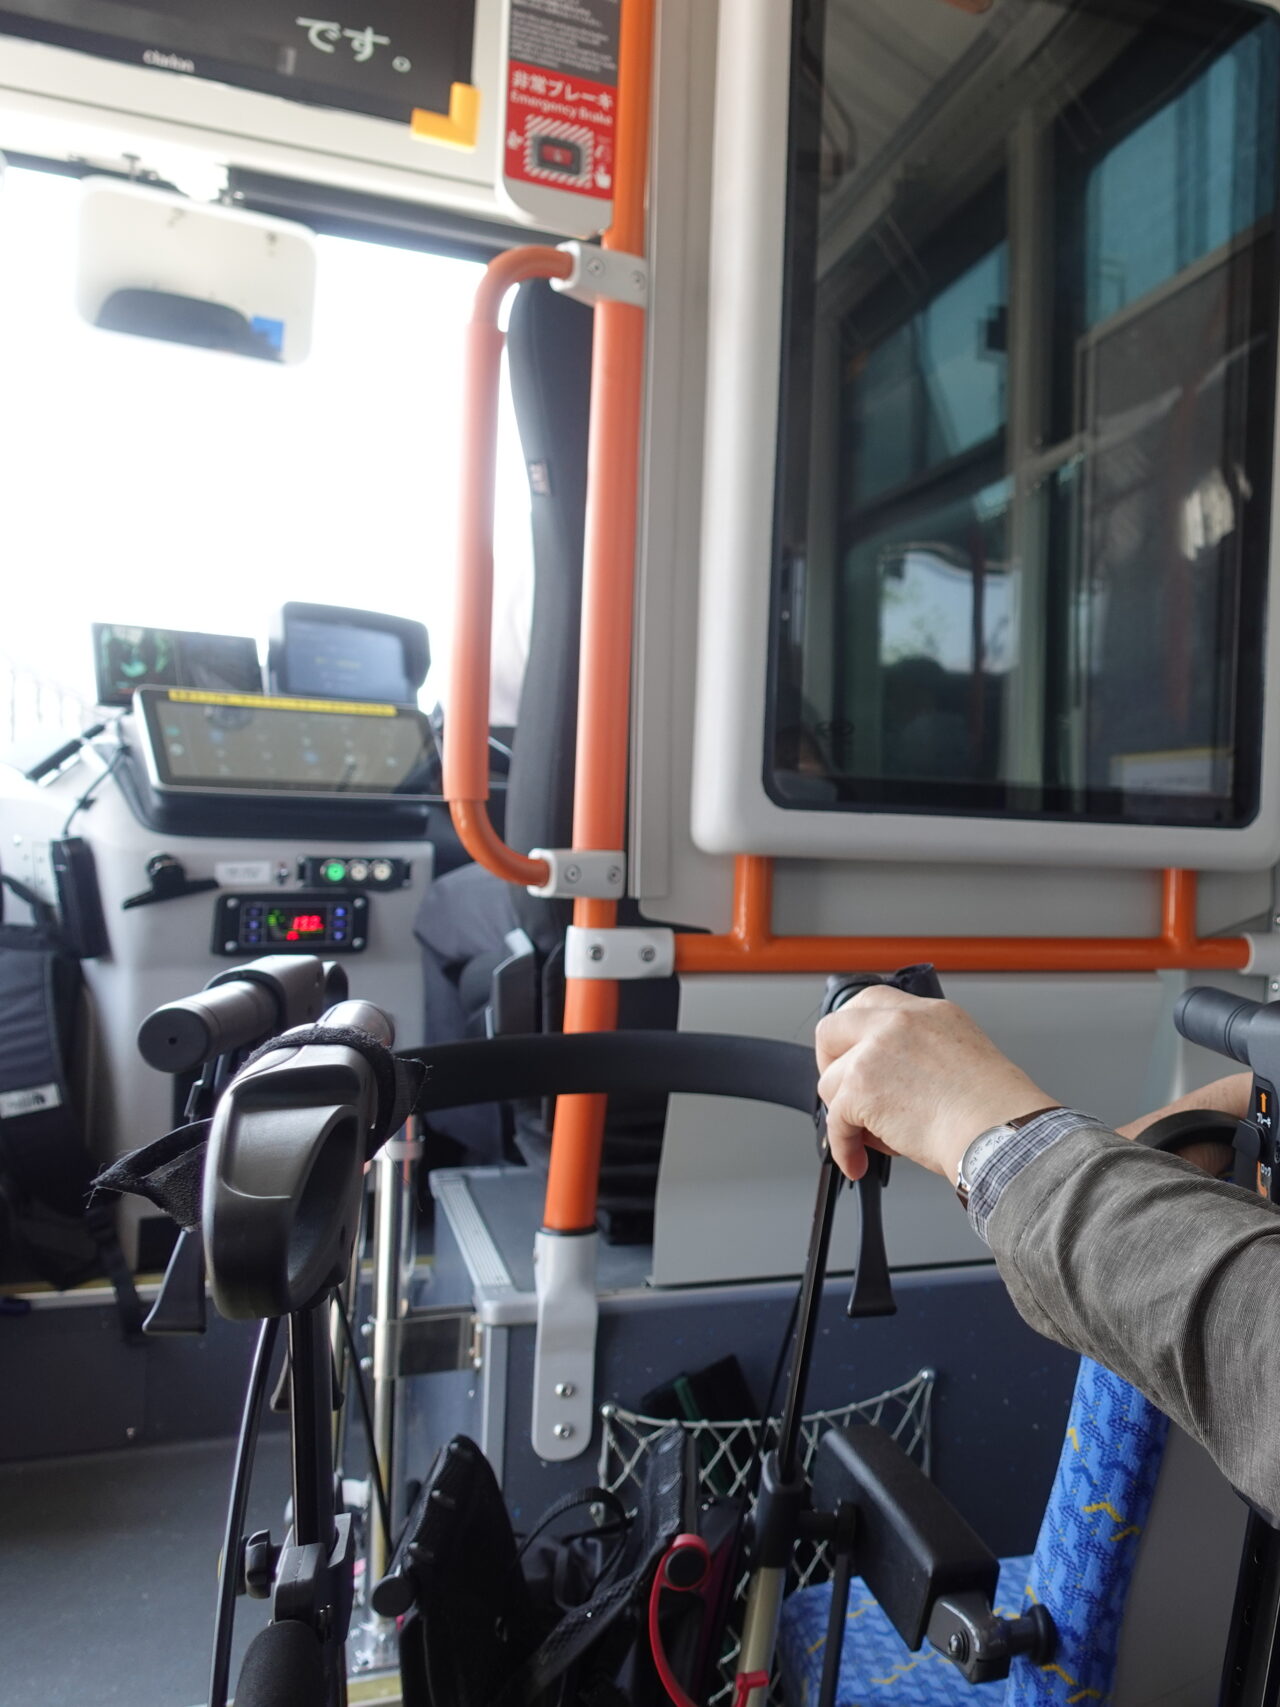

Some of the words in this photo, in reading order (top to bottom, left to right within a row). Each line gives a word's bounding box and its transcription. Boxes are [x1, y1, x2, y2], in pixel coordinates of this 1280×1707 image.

[295, 16, 411, 73] です。
[509, 88, 578, 120] Emergency
[577, 106, 614, 127] Brake
[511, 69, 614, 112] 非常ブレーキ
